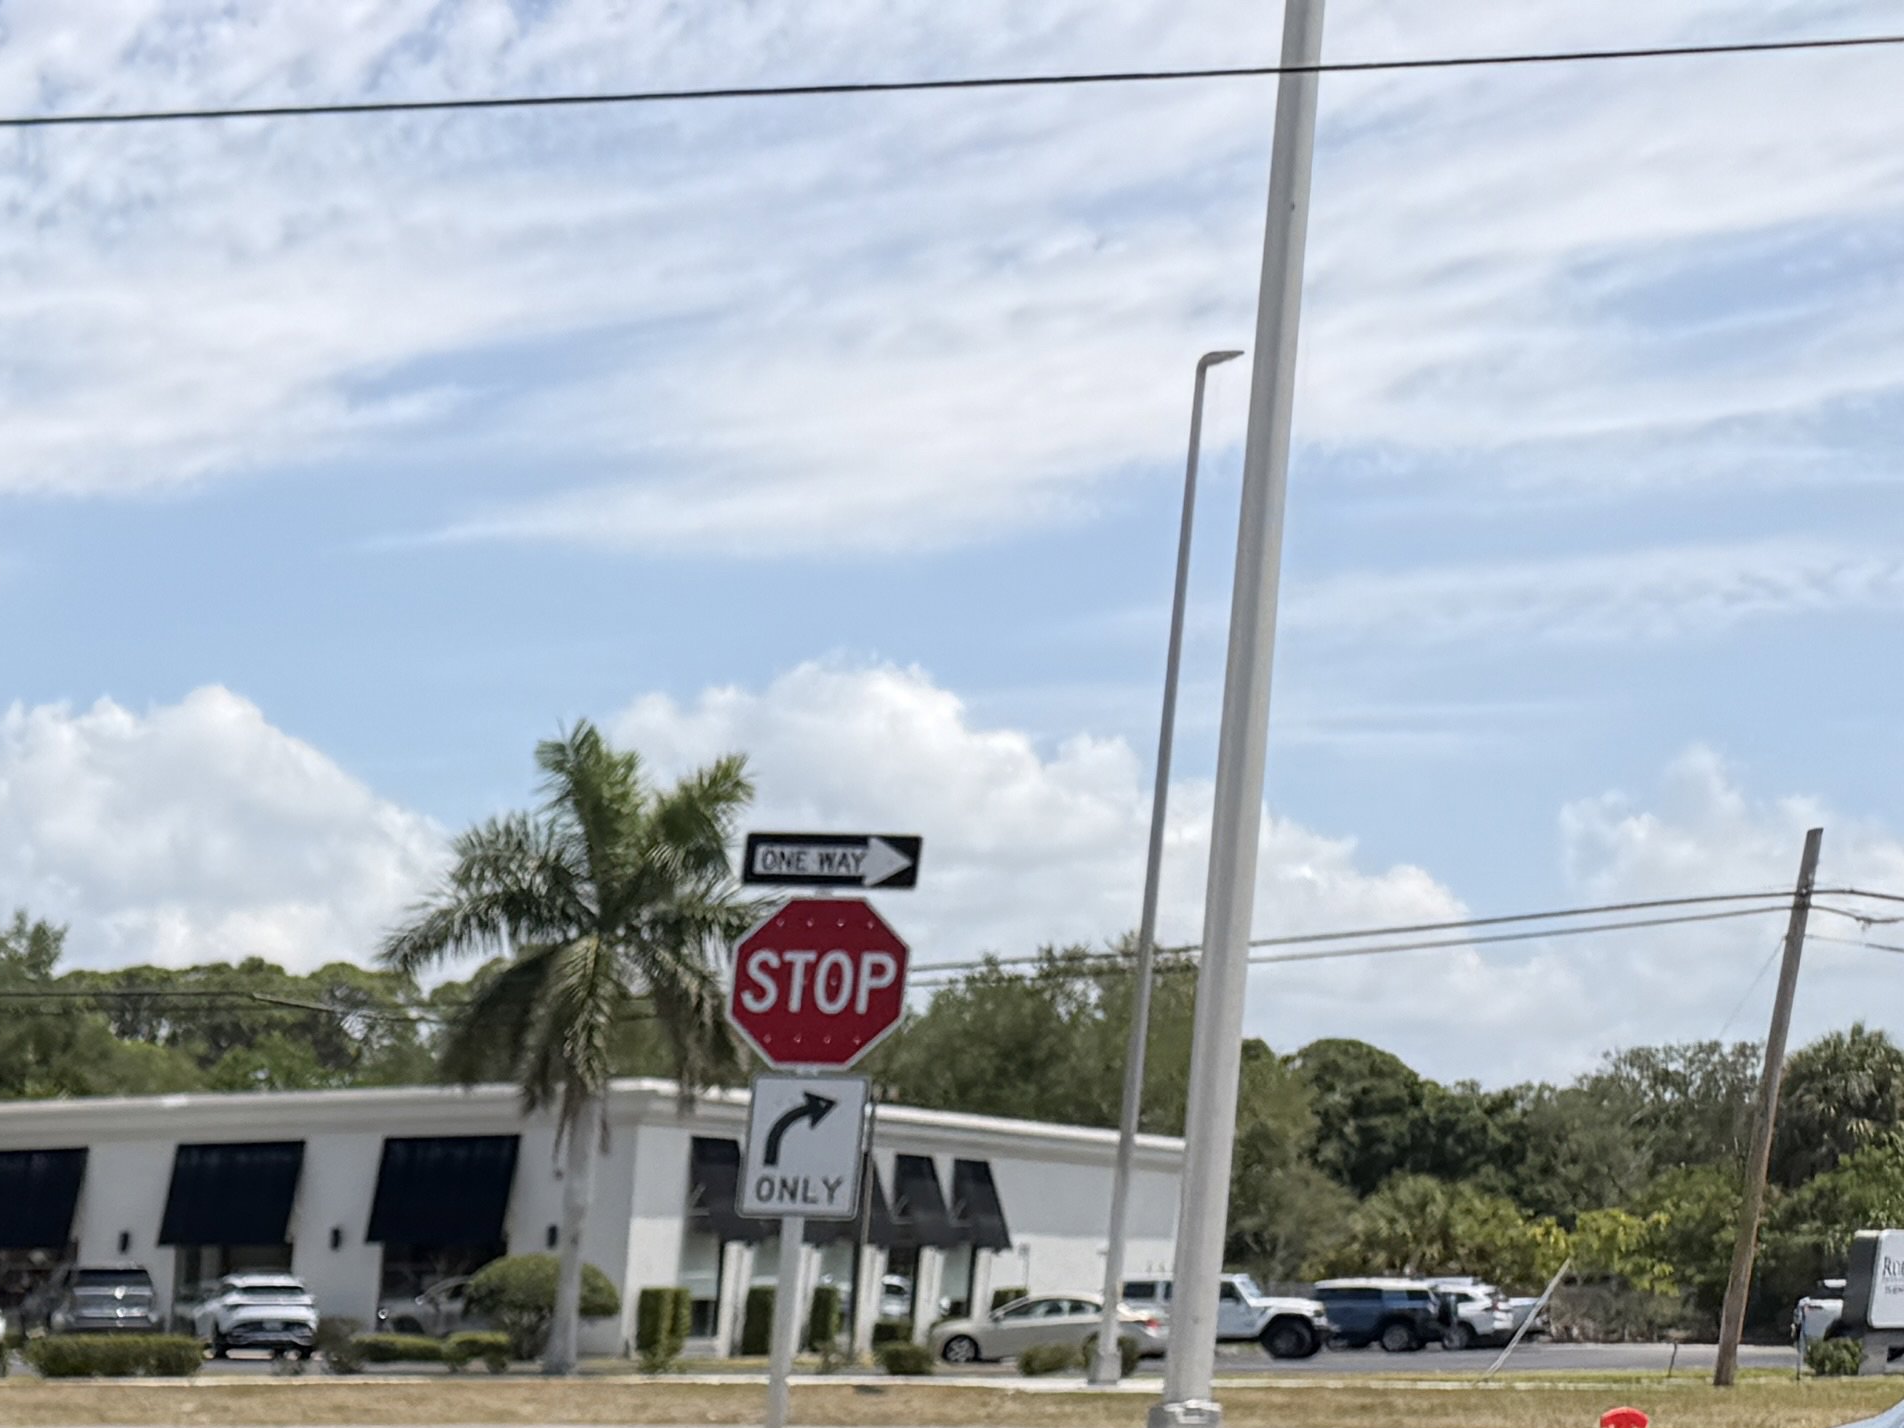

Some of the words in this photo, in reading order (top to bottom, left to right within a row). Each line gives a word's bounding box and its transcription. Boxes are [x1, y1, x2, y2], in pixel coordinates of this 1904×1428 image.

[762, 848, 808, 871] ONE
[818, 851, 867, 873] WAY
[740, 949, 897, 1015] STOP
[755, 1175, 843, 1205] ONLY
